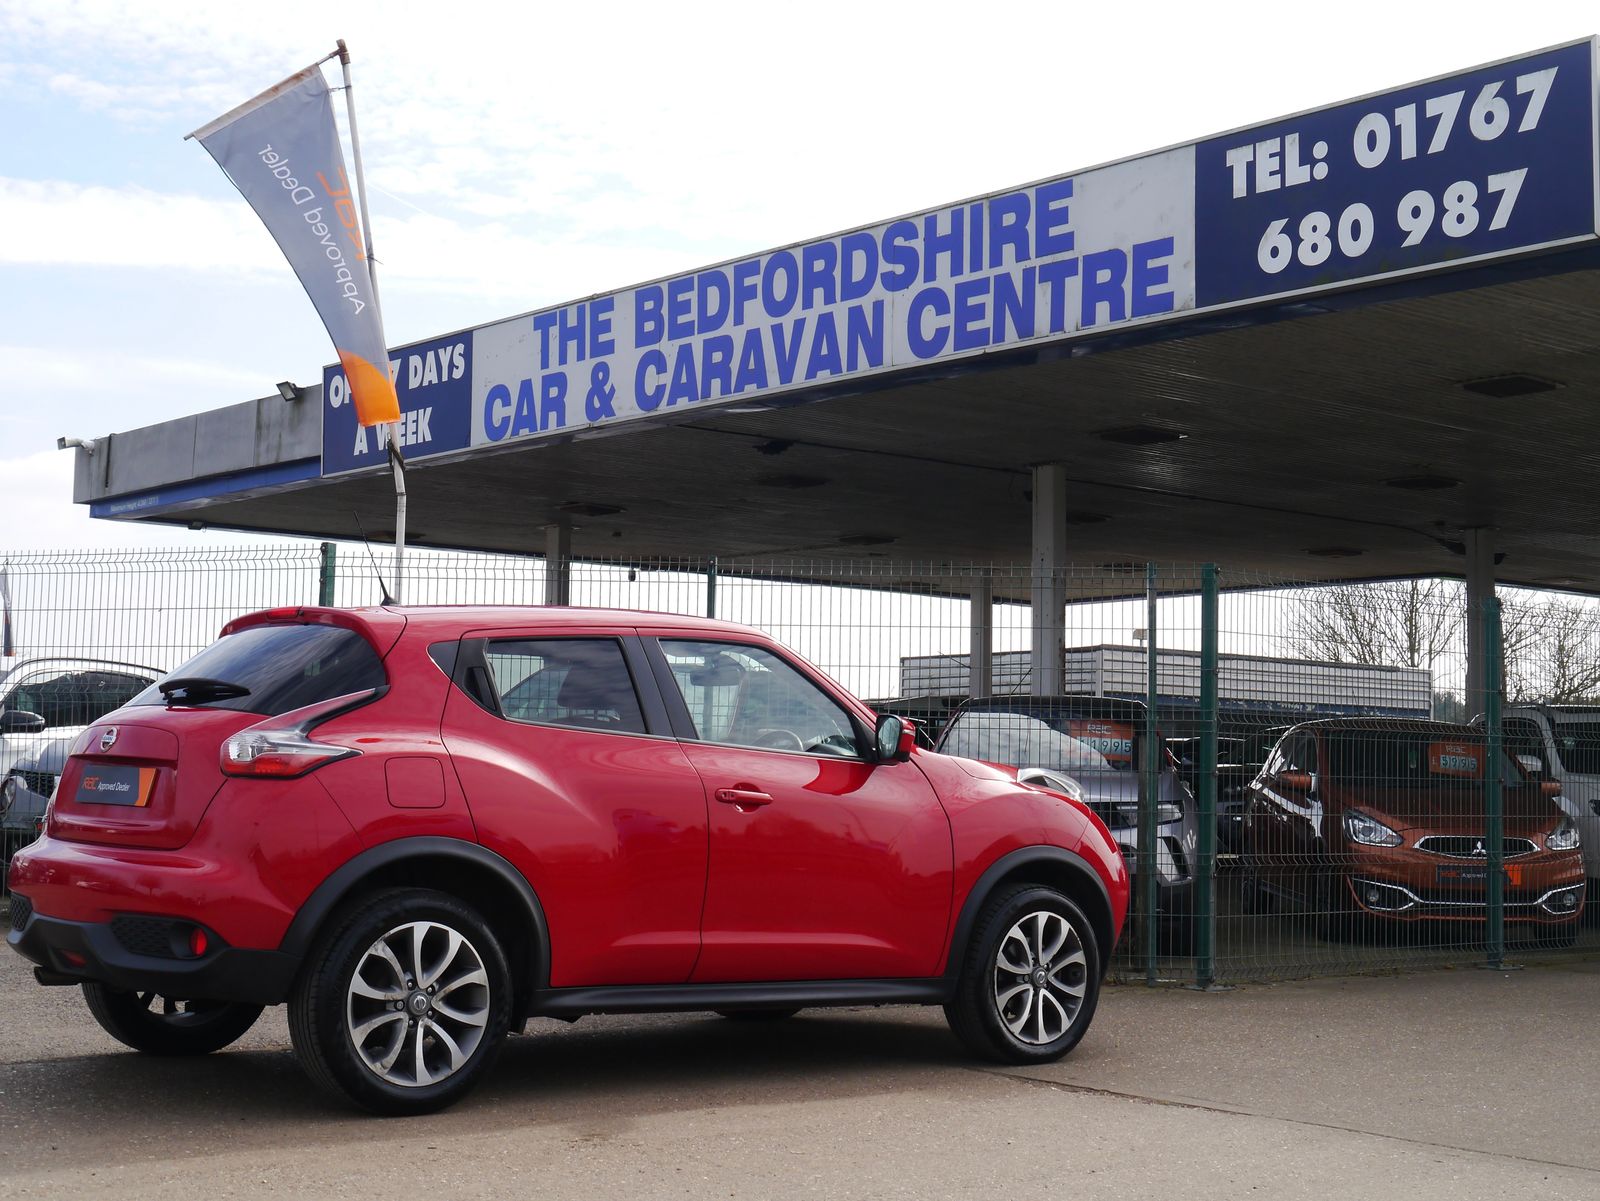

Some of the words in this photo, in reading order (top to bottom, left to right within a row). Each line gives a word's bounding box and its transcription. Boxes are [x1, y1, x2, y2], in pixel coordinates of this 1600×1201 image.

[1225, 132, 1329, 199] TEL:
[1353, 66, 1559, 169] 01767
[533, 297, 616, 371] THE
[634, 179, 1074, 350] BEDFORDSHIRE
[1257, 202, 1375, 274] 680
[1397, 167, 1529, 248] 987
[408, 343, 465, 390] DAYS
[484, 371, 568, 442] CAR
[585, 361, 616, 422] &
[634, 300, 884, 412] CARAVAN
[907, 236, 1174, 360] CENTRE
[353, 423, 369, 456] A
